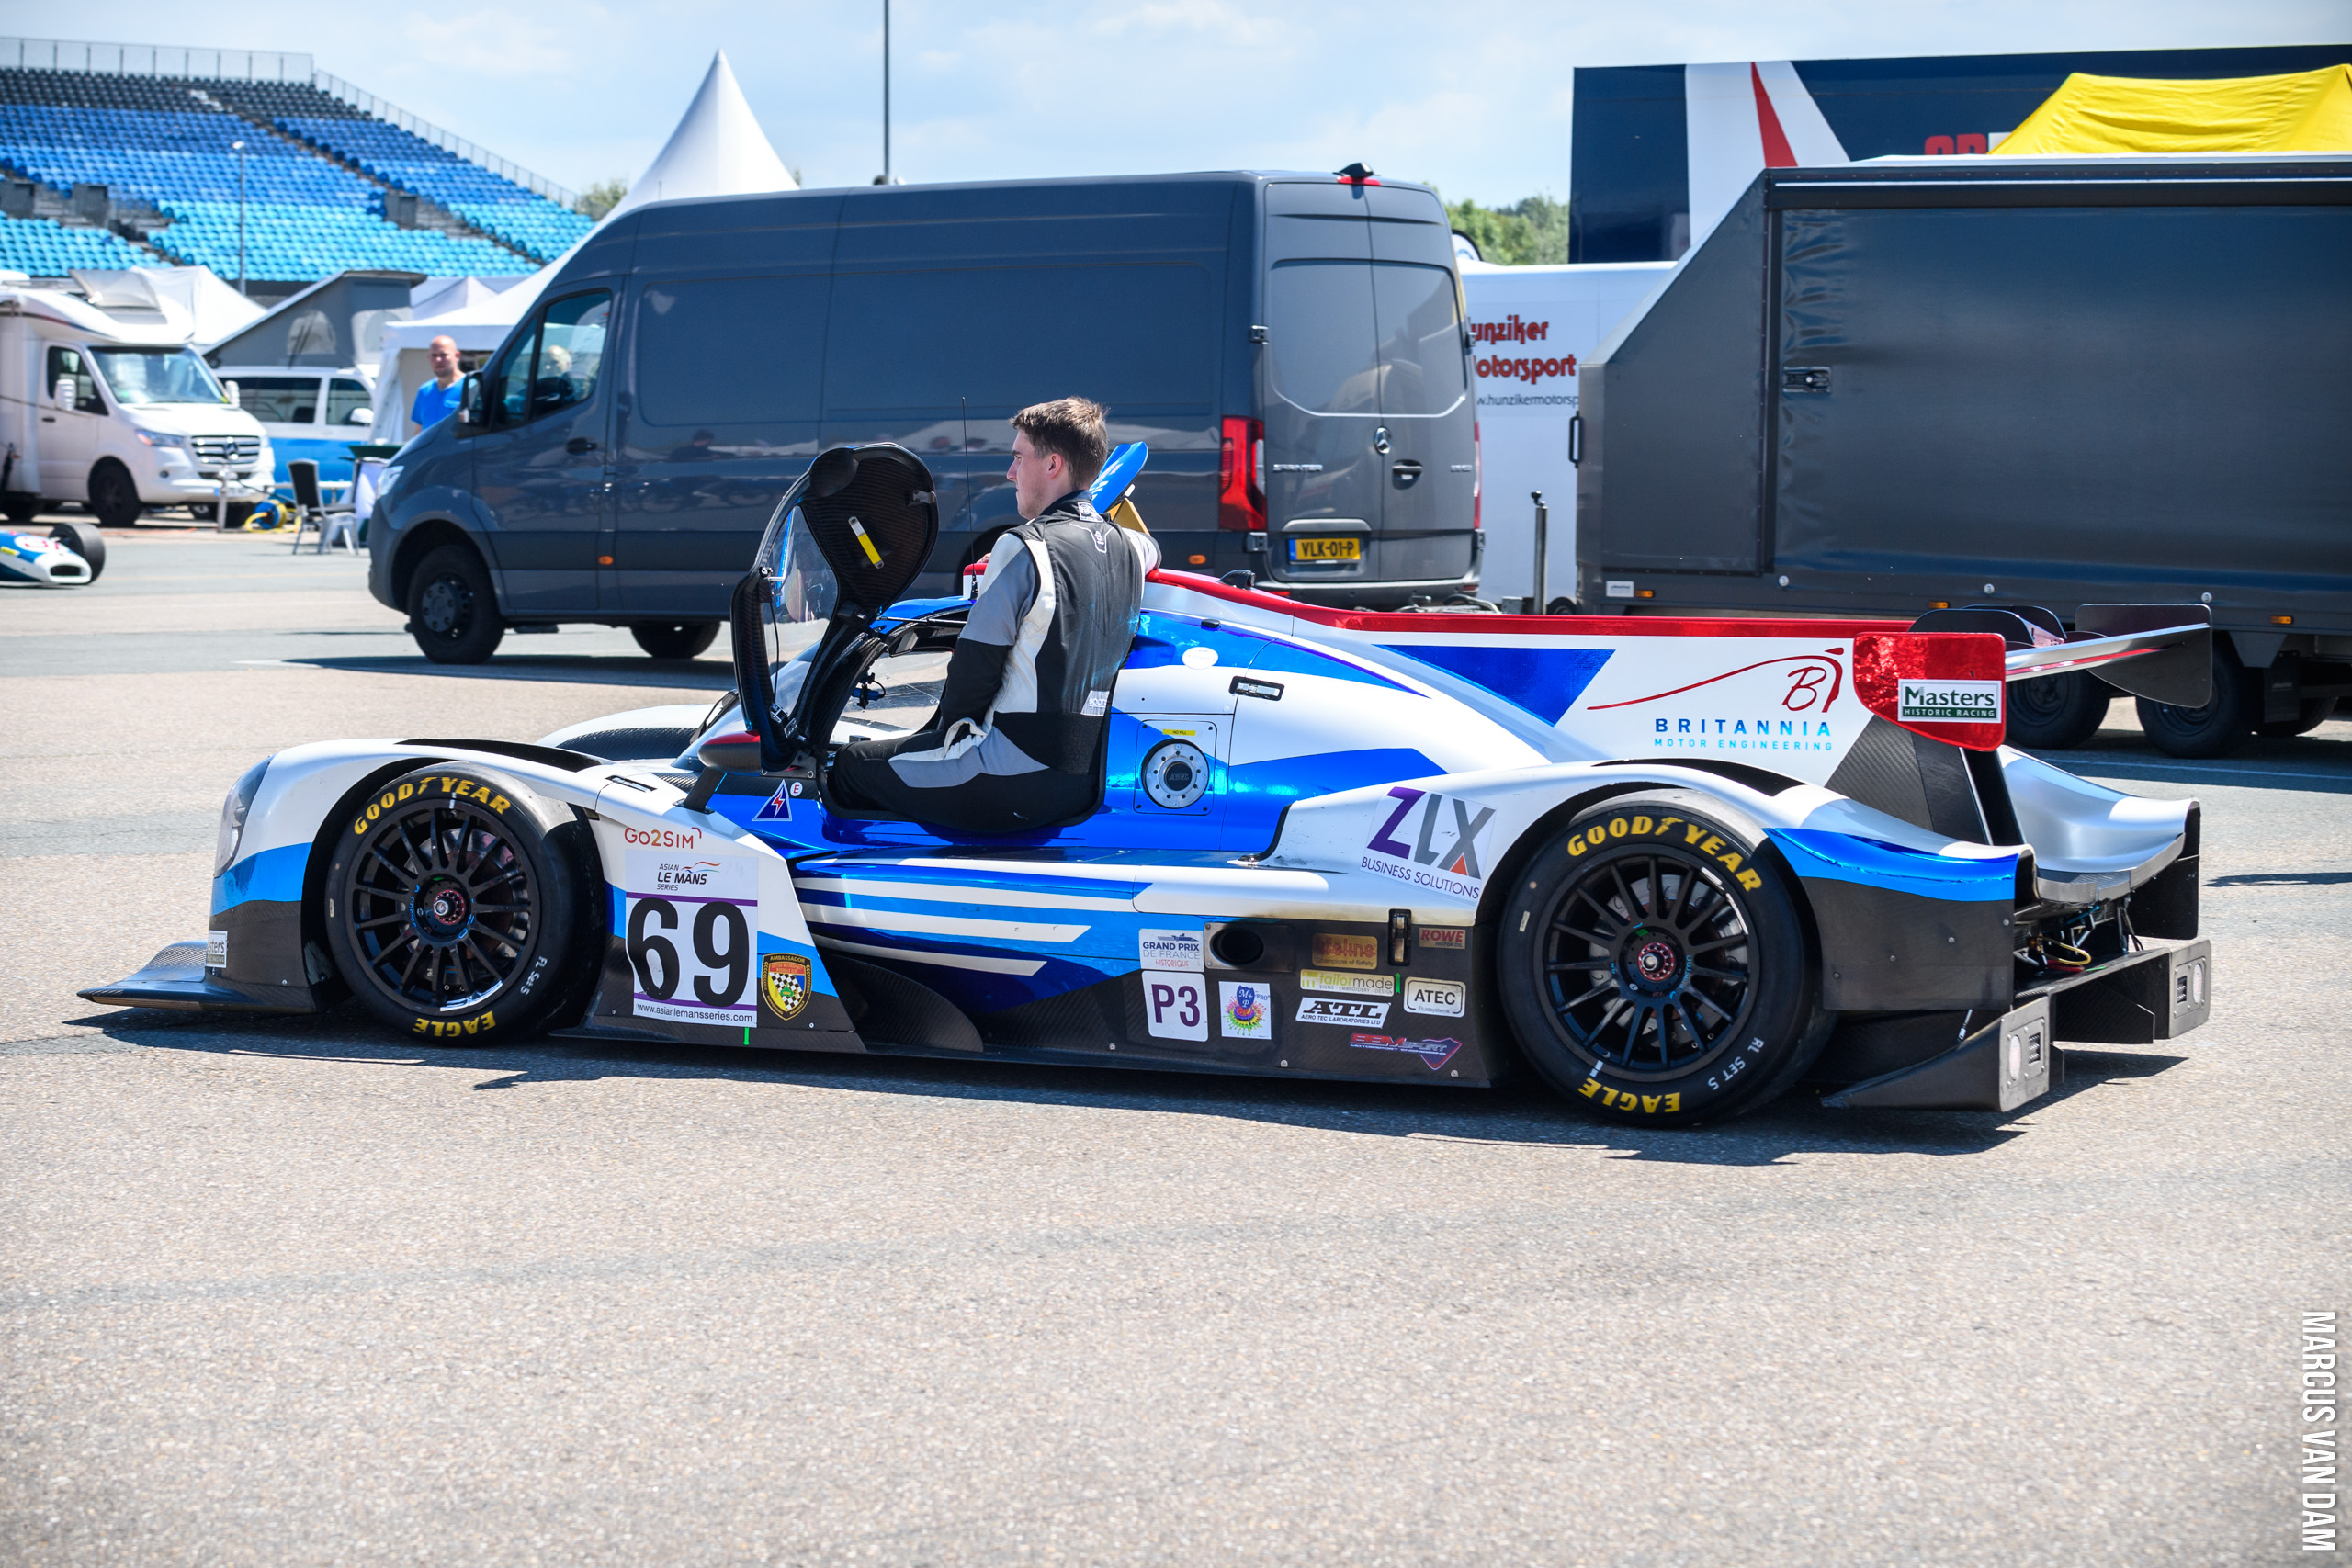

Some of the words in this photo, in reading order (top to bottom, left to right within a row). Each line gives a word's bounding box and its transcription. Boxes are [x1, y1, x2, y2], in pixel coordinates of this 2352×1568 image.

[1466, 314, 1549, 345] unziker
[1473, 354, 1577, 385] otorsport
[1301, 541, 1355, 558] VLK-01-P
[1905, 686, 1995, 706] Masters
[1904, 708, 1951, 716] HISTORIC
[1956, 709, 1995, 717] RACING
[1655, 717, 1832, 737] BRITANNIA
[1654, 739, 1707, 748] MOTOR
[1718, 739, 1832, 750] ENGINEERING
[793, 784, 800, 794] E
[1366, 785, 1497, 880] ZLX
[659, 863, 679, 872] ASIAN
[657, 872, 671, 883] LE
[673, 873, 707, 885] MANS
[1361, 856, 1412, 881] BUSINESS
[1413, 871, 1480, 899] SOLUTIONS
[656, 883, 679, 891] SERIES
[1420, 929, 1464, 942] ROWE
[627, 897, 750, 1008] 69
[1142, 941, 1176, 951] GRAND
[1178, 942, 1200, 952] PRIX
[1142, 949, 1156, 958] DE
[1159, 950, 1200, 960] FRANCE
[769, 955, 806, 964] AMBASSADOR
[1155, 958, 1189, 967] HISTORIQUE
[1319, 970, 1393, 989] tailormade
[1150, 983, 1200, 1028] P3
[1414, 989, 1456, 1006] ATEC
[637, 1003, 752, 1022] www.asianlemansseries.com
[1303, 1000, 1384, 1019] ATL
[413, 1010, 497, 1038] EAGLE
[1329, 1016, 1371, 1024] LABORATORIES
[1747, 1036, 1764, 1054] RL
[1724, 1056, 1747, 1082] SET
[1577, 1077, 1680, 1114] EAGLE
